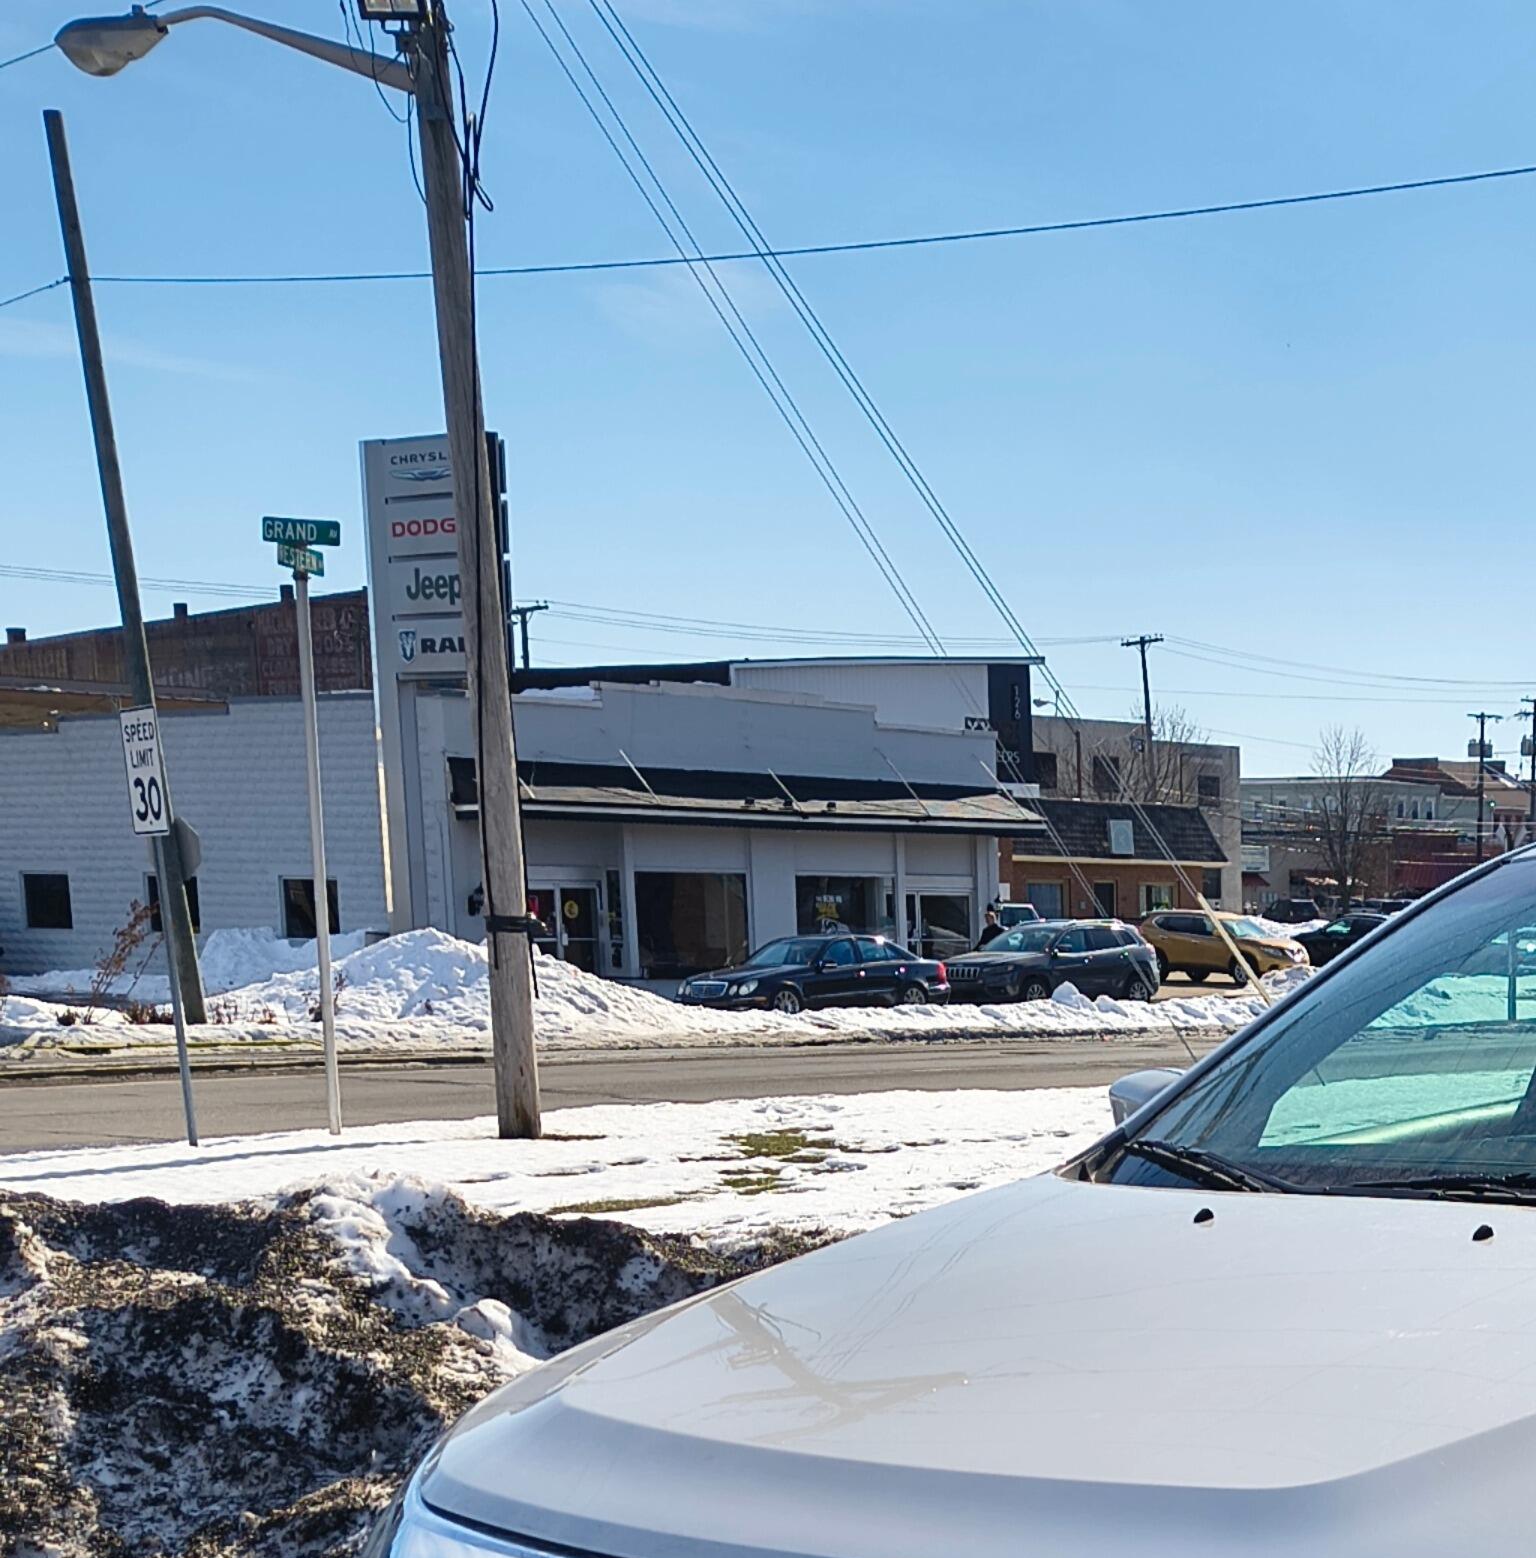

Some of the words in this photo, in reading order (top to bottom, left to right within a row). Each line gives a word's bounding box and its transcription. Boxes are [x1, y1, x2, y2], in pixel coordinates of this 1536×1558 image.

[390, 451, 447, 465] CHRYSL
[264, 520, 317, 541] GRAND
[391, 517, 456, 538] DODG
[406, 567, 461, 606] Jeep
[124, 721, 155, 743] SPEED
[130, 748, 154, 769] LIMIT
[133, 776, 161, 821] 30
